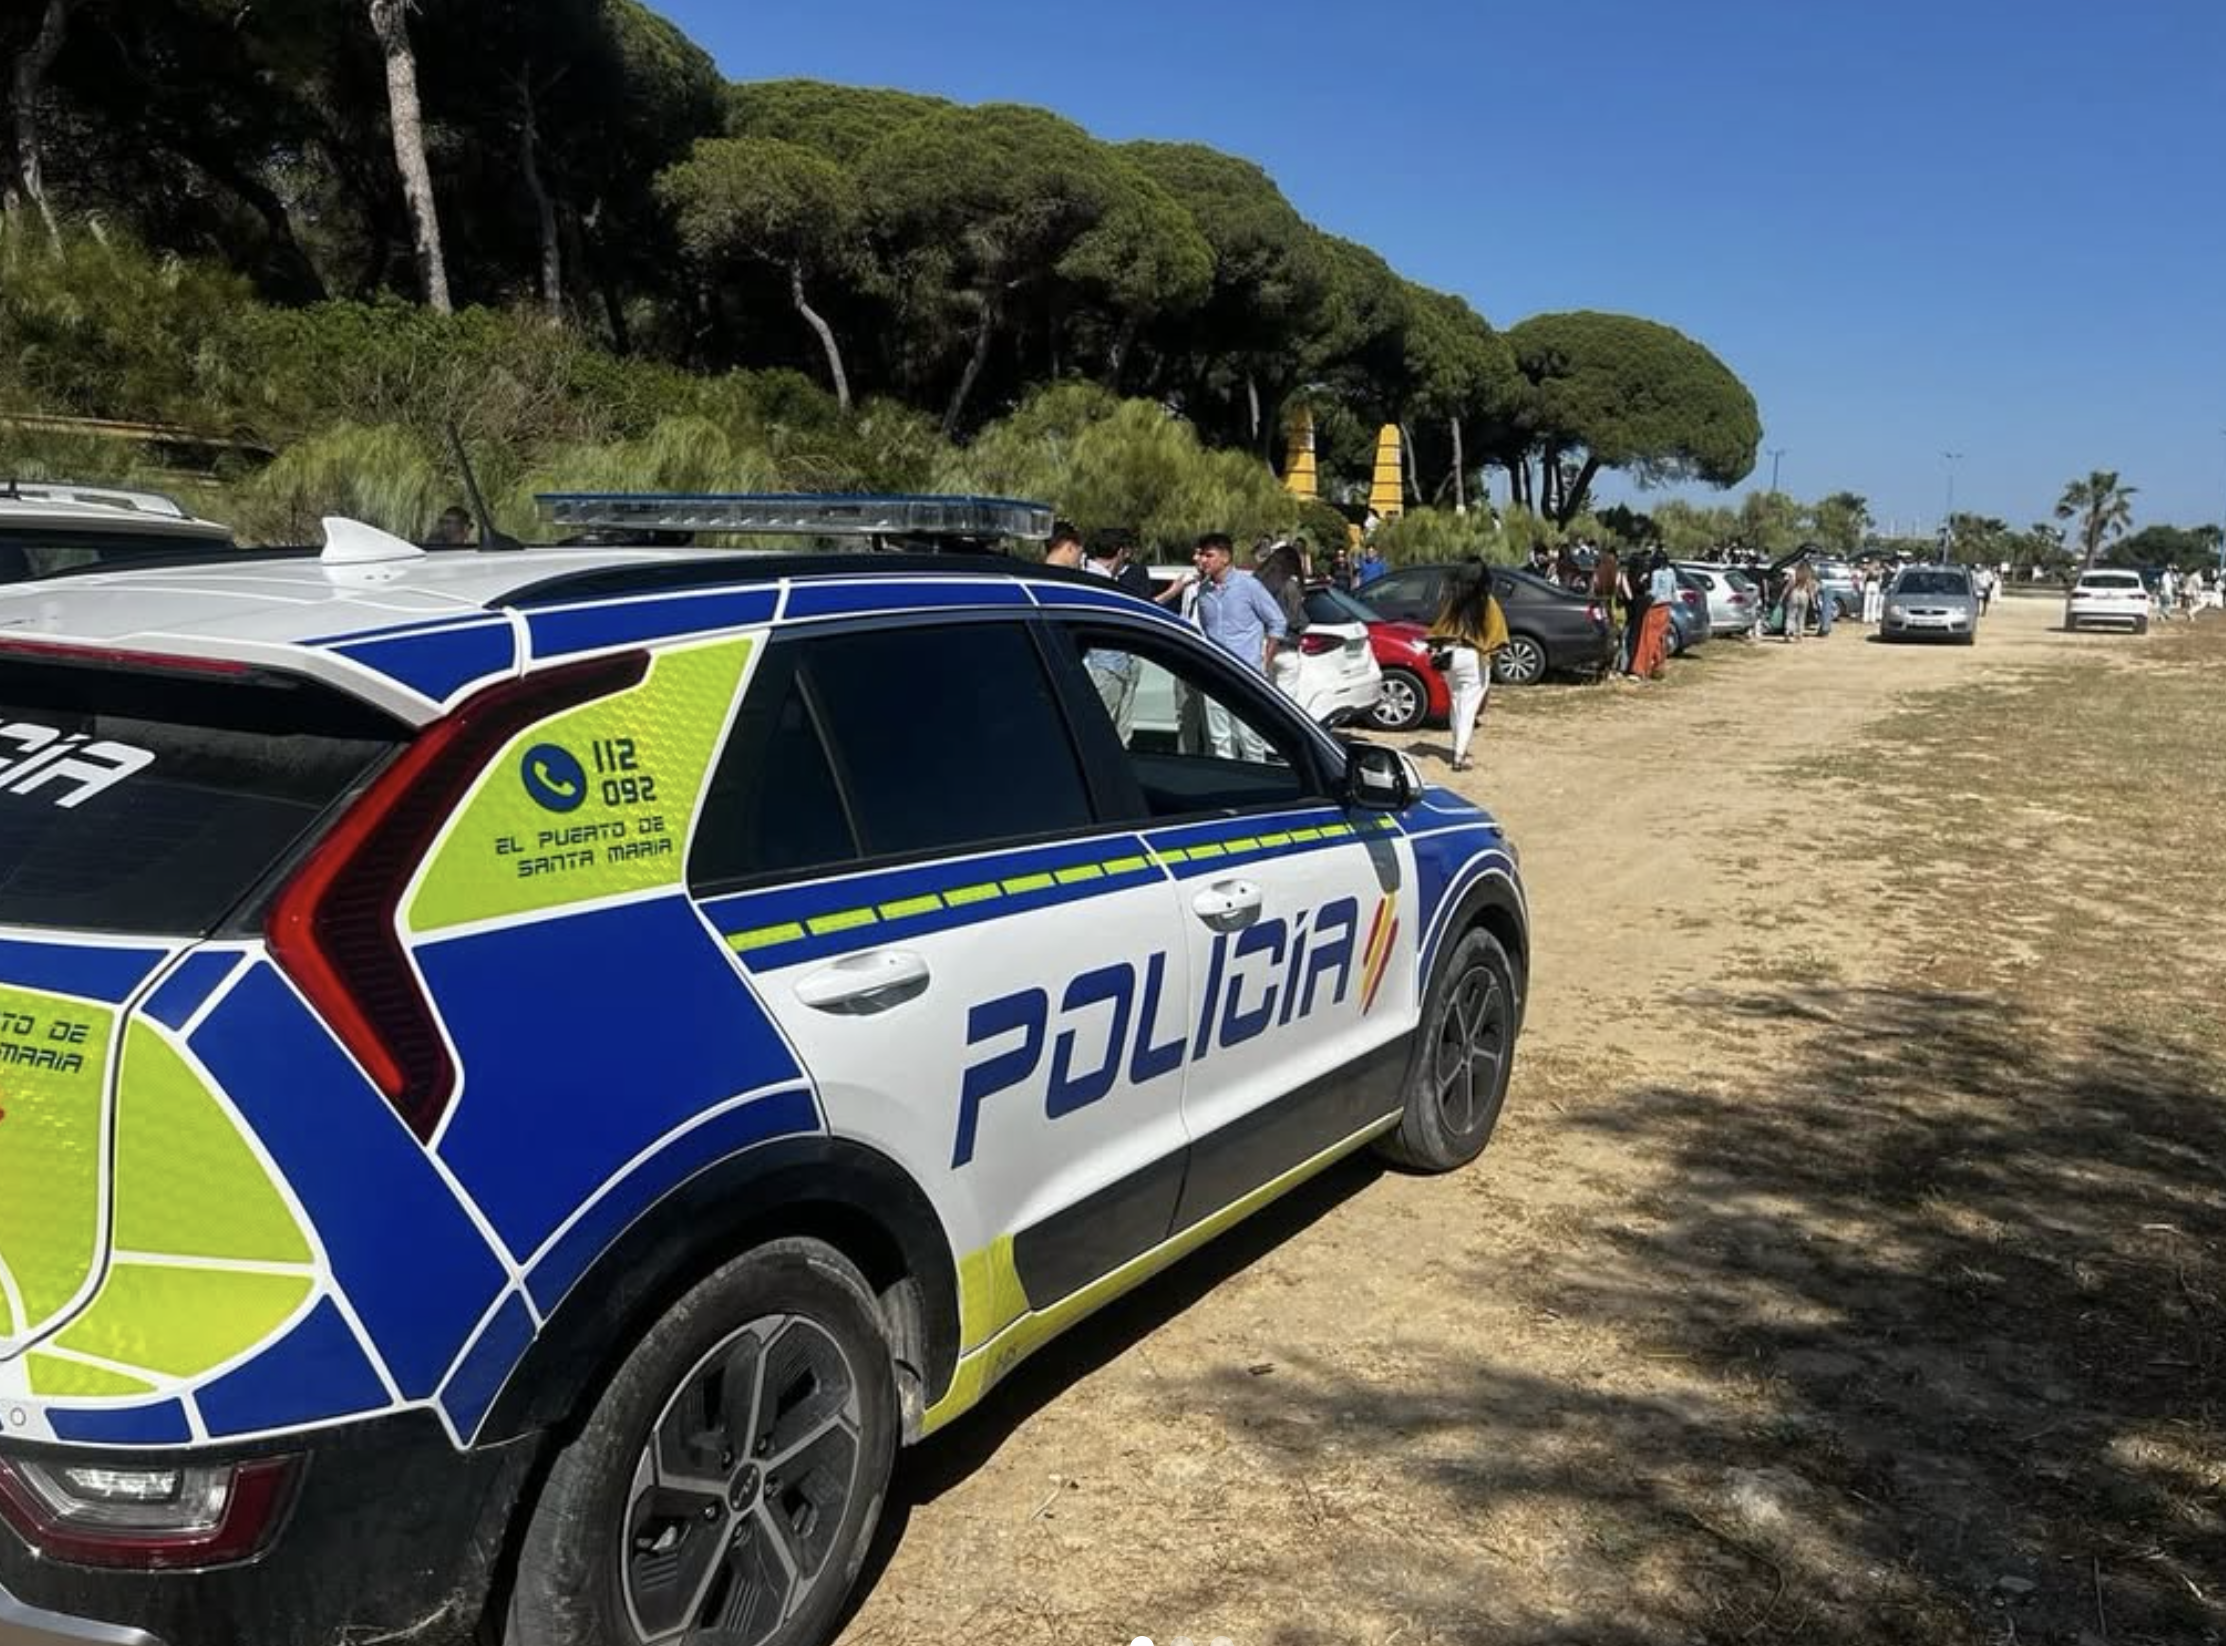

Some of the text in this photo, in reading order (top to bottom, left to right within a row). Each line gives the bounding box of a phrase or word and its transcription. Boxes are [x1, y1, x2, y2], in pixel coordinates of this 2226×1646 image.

[592, 738, 639, 773] 112
[601, 776, 657, 807] 092
[495, 816, 664, 855] EL PUERTO DE
[517, 850, 594, 878] SANTA
[48, 1021, 90, 1043] DE
[951, 896, 1359, 1170] POLICÍA
